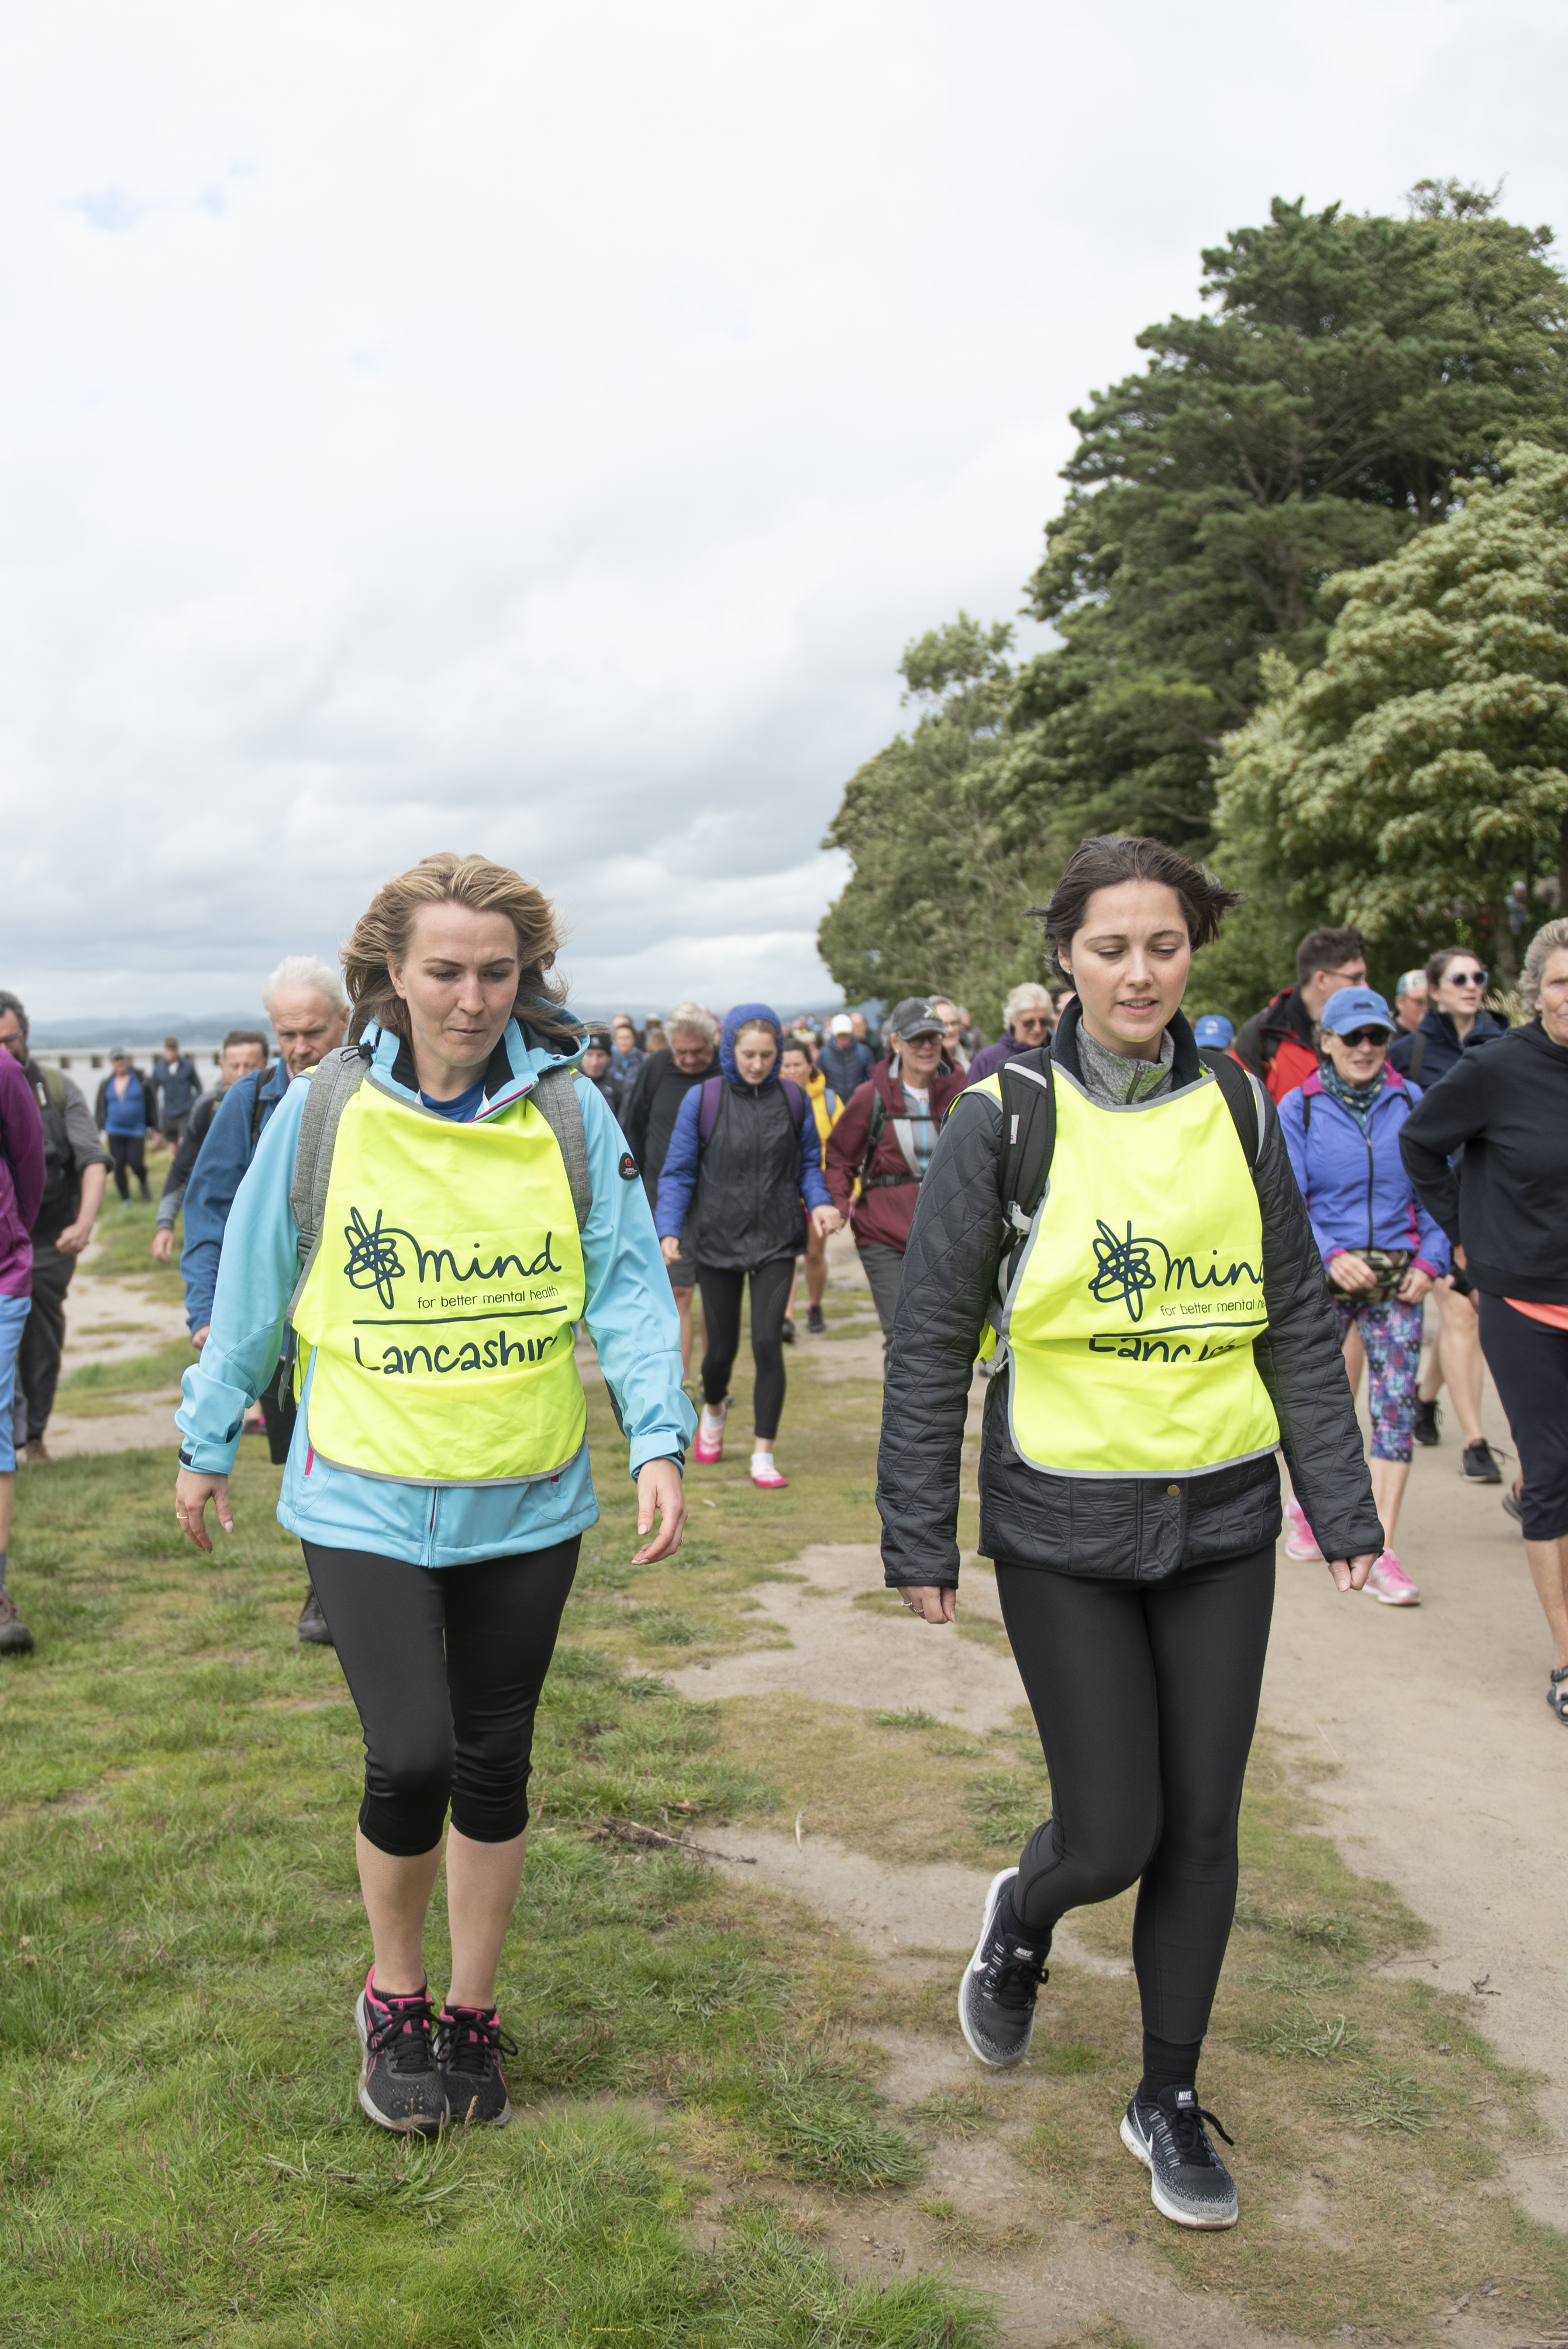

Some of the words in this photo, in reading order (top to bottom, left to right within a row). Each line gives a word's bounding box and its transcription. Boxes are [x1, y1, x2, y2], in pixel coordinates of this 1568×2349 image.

[418, 1231, 562, 1283] mind
[1164, 1249, 1264, 1292] min
[418, 1297, 436, 1309] for
[441, 1294, 477, 1308] better
[483, 1290, 525, 1304] mental
[530, 1285, 559, 1301] health
[1160, 1305, 1176, 1316] for
[1181, 1302, 1212, 1315] better
[1217, 1298, 1255, 1312] mental
[354, 1330, 558, 1375] Lancashir
[1015, 1947, 1033, 1957] NIKE
[1178, 2090, 1192, 2101] NIKE
